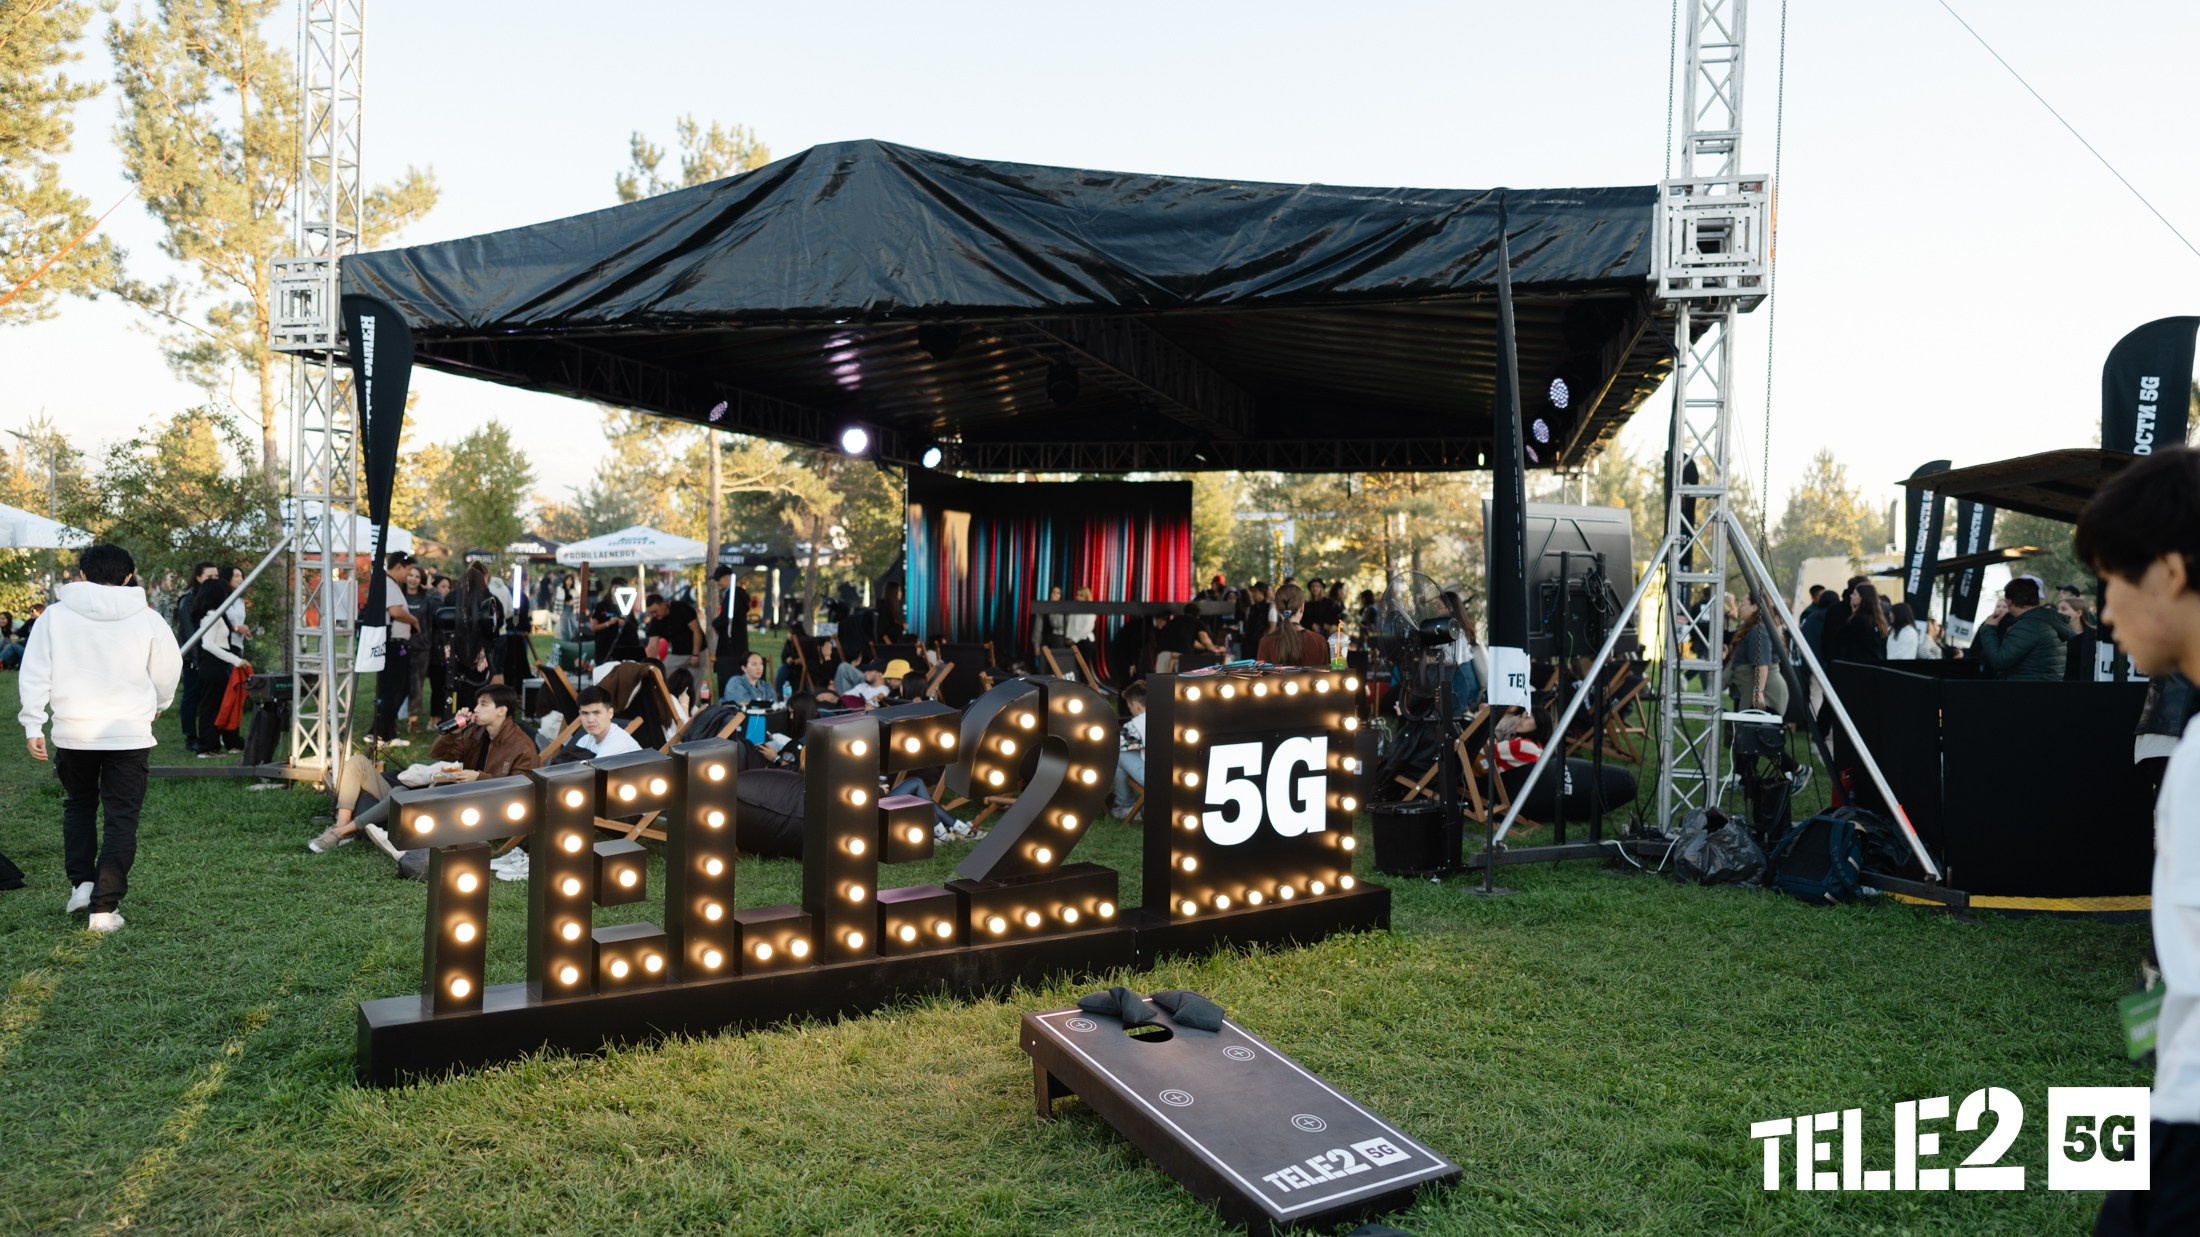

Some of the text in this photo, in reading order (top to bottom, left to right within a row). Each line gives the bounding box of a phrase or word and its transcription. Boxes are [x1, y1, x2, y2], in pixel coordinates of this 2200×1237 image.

[2133, 376, 2160, 456] ОСТИ 5G
[389, 675, 1328, 1012] TELE2 5G
[1262, 1144, 1398, 1193] TELE2 5G
